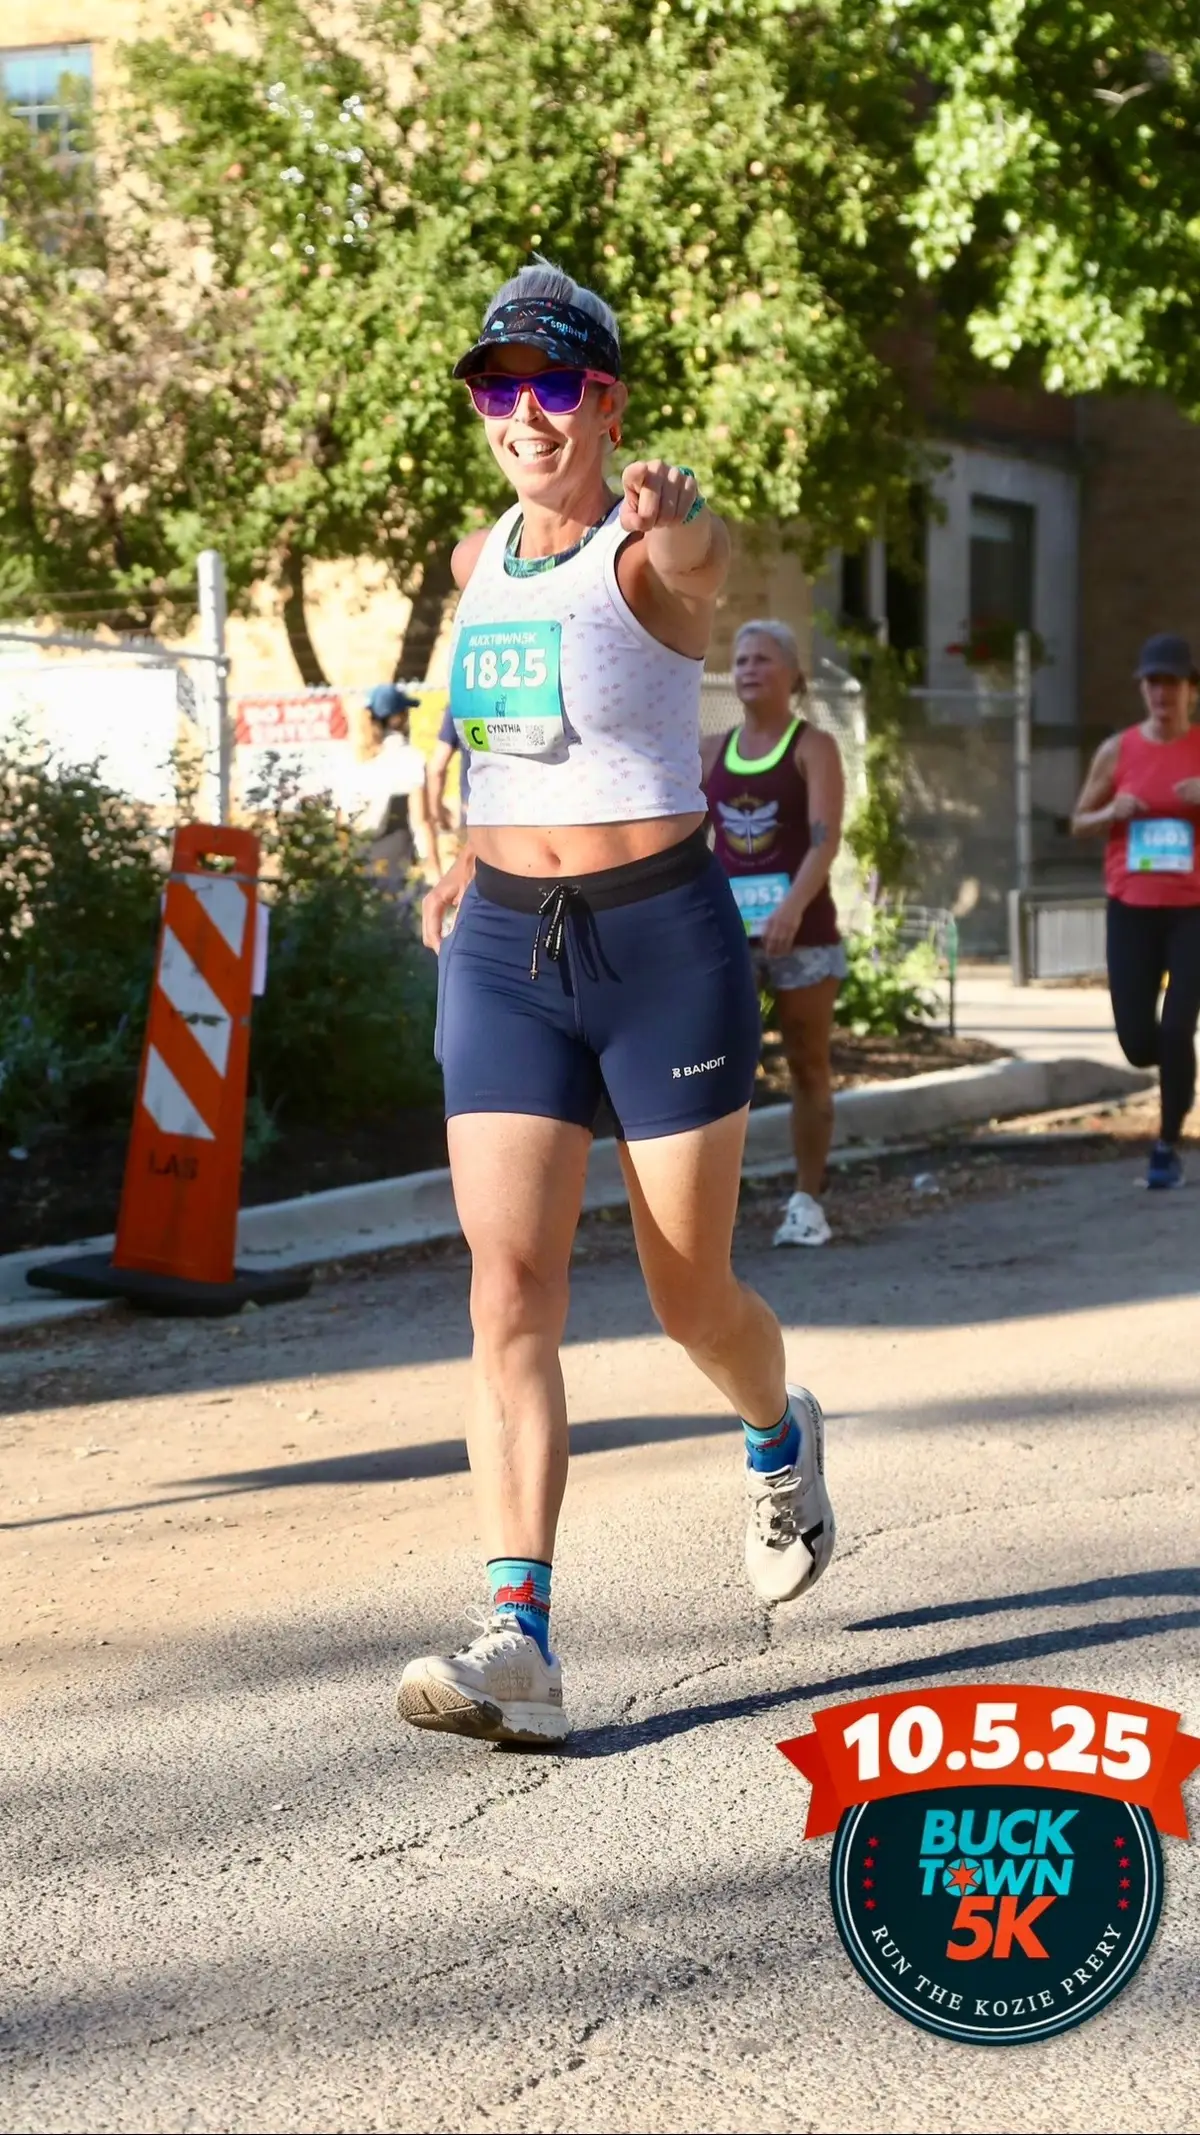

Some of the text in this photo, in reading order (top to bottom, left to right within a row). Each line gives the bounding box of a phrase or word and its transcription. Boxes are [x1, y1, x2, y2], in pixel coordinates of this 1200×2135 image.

[462, 648, 548, 690] 1825
[470, 727, 483, 745] C
[487, 724, 521, 734] CYNTHIA
[683, 1056, 726, 1076] BANDIT
